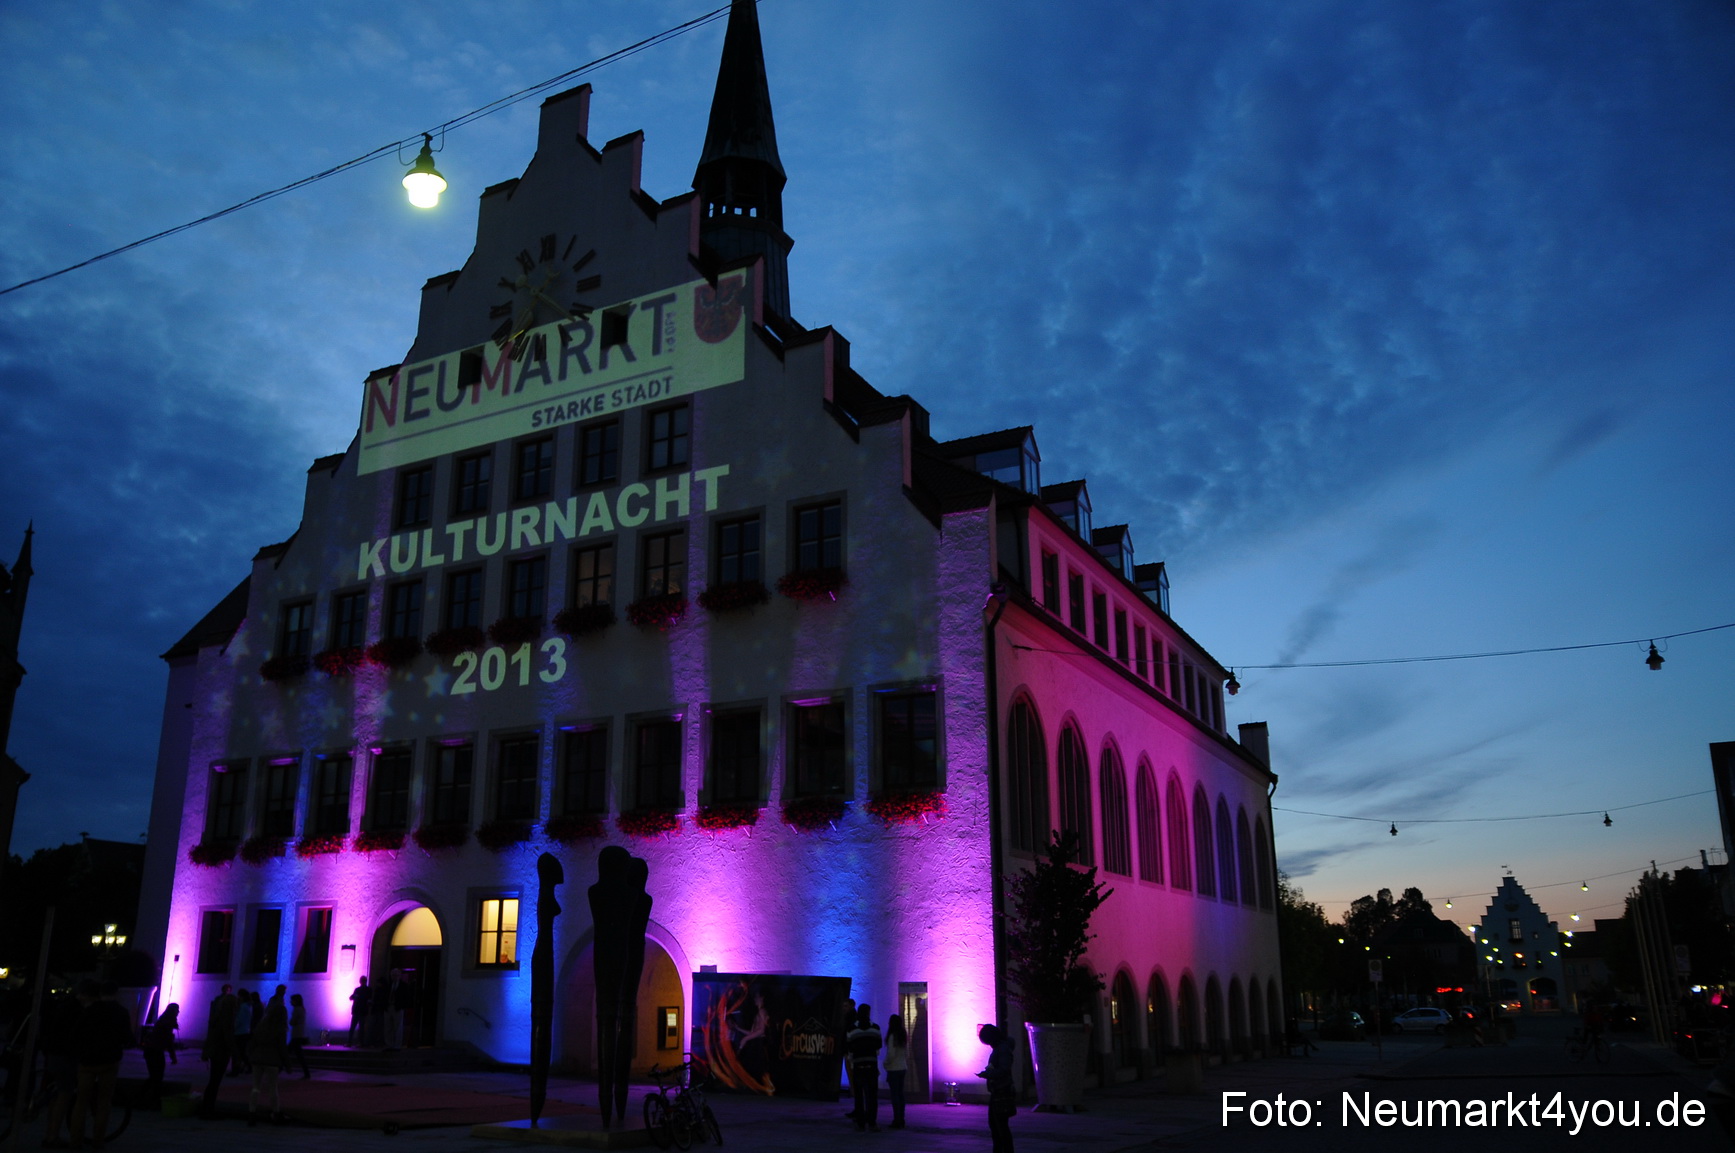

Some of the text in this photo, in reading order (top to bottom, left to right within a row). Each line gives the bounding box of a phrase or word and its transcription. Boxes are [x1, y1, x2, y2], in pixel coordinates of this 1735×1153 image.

[531, 376, 674, 428] STARKE STADT
[357, 464, 730, 581] KULTURNACHT
[450, 637, 568, 696] 2013
